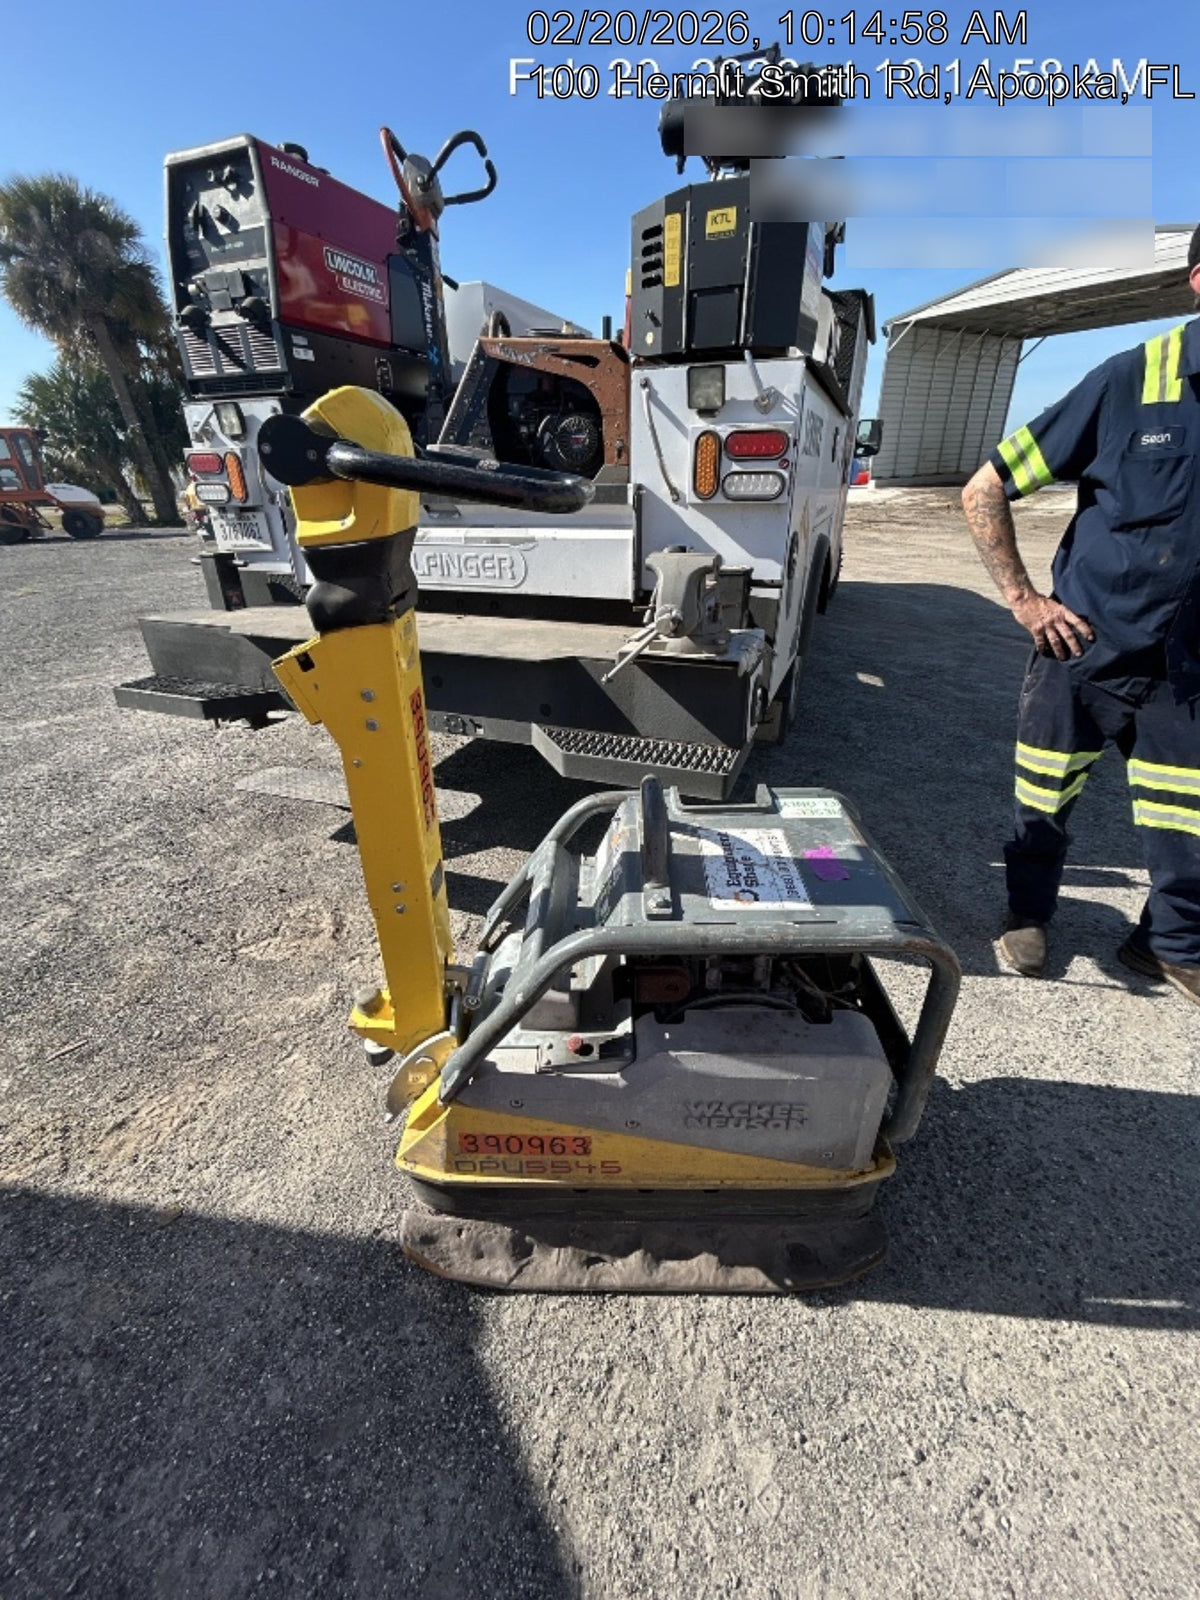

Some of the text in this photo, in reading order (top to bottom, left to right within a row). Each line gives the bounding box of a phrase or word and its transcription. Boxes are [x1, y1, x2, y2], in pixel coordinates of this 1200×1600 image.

[271, 155, 319, 187] RANGER
[326, 251, 376, 284] LINCOLN
[684, 1116, 808, 1131] NEUSON
[462, 1132, 592, 1156] 390963
[453, 1159, 623, 1175] DPU5545
